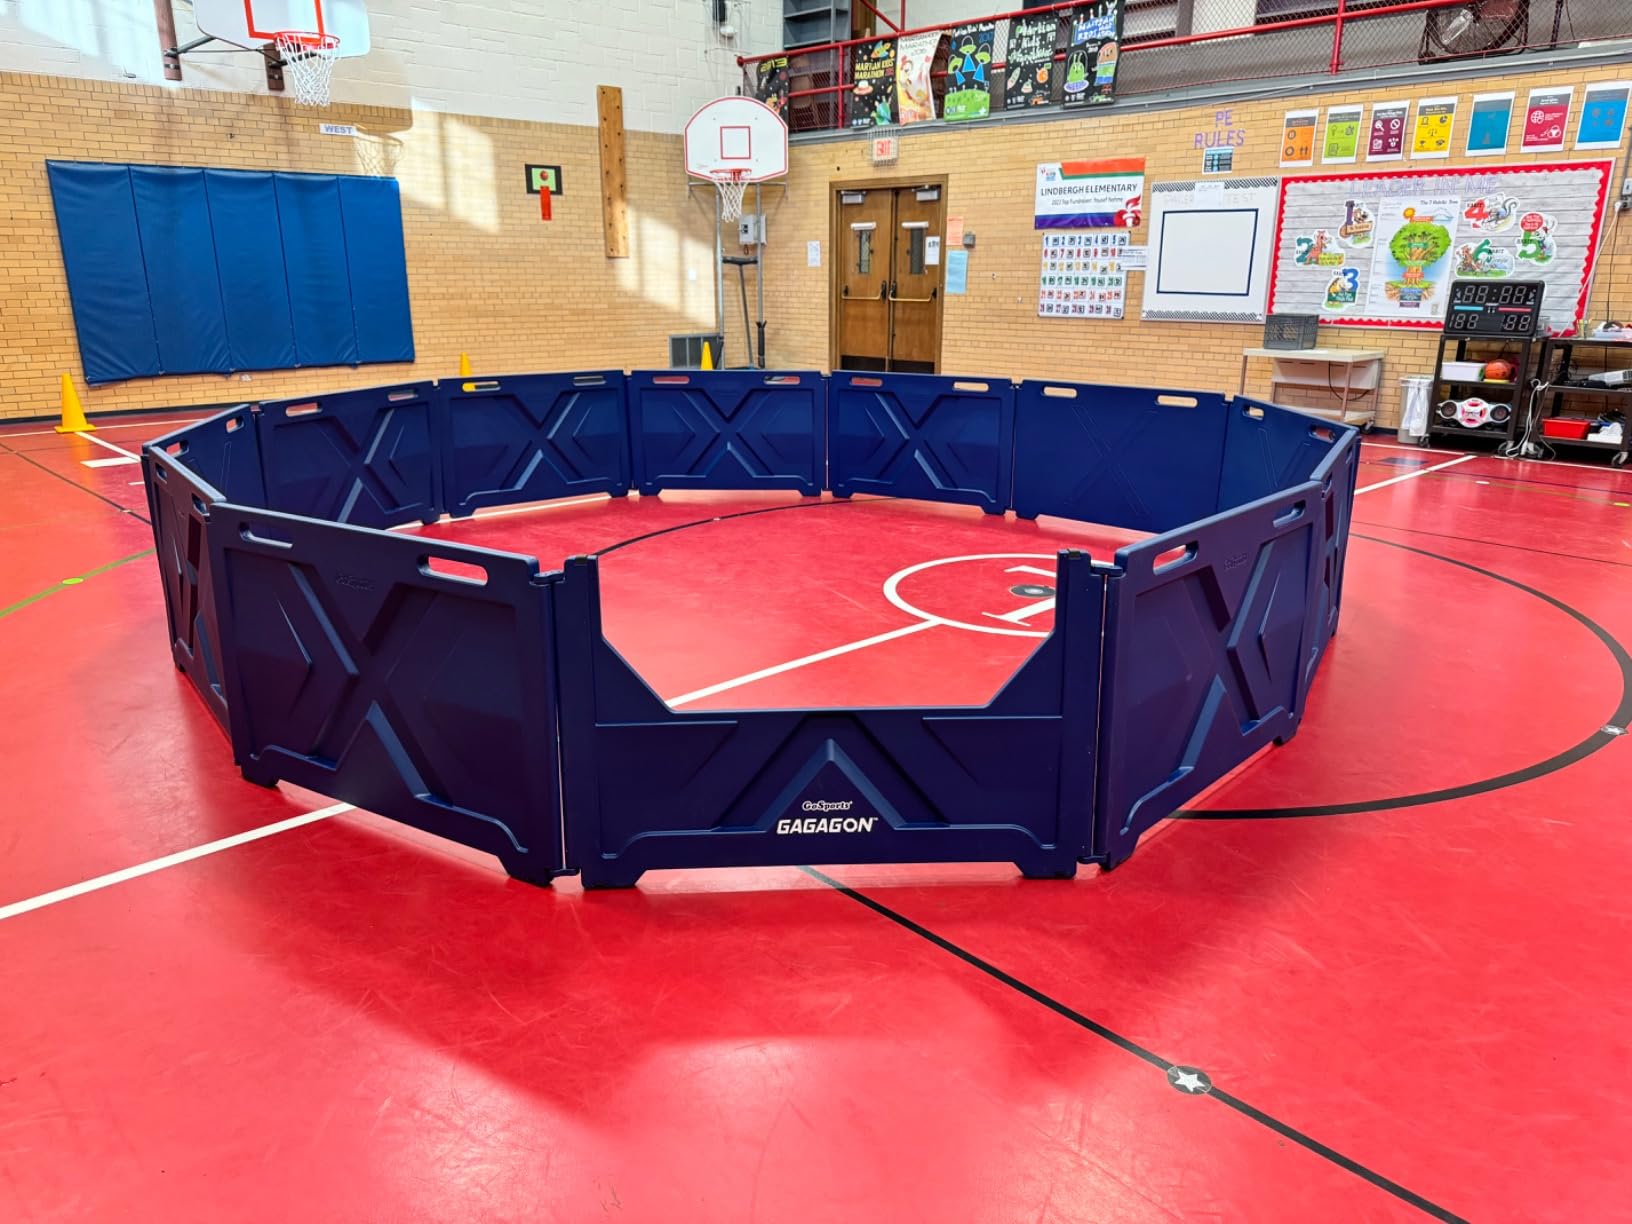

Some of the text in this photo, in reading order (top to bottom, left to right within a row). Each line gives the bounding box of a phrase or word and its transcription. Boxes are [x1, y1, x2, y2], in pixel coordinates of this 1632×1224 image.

[1215, 109, 1233, 127] PE
[325, 125, 353, 134] WEST
[1194, 130, 1246, 149] RULES
[1041, 183, 1138, 196] LINDBERGH ELEMENTARY
[1464, 199, 1489, 221] 4
[1296, 237, 1314, 263] 2
[1473, 239, 1492, 263] 6
[1519, 229, 1541, 259] 5
[1342, 268, 1359, 291] 3
[802, 800, 853, 812] GoSports
